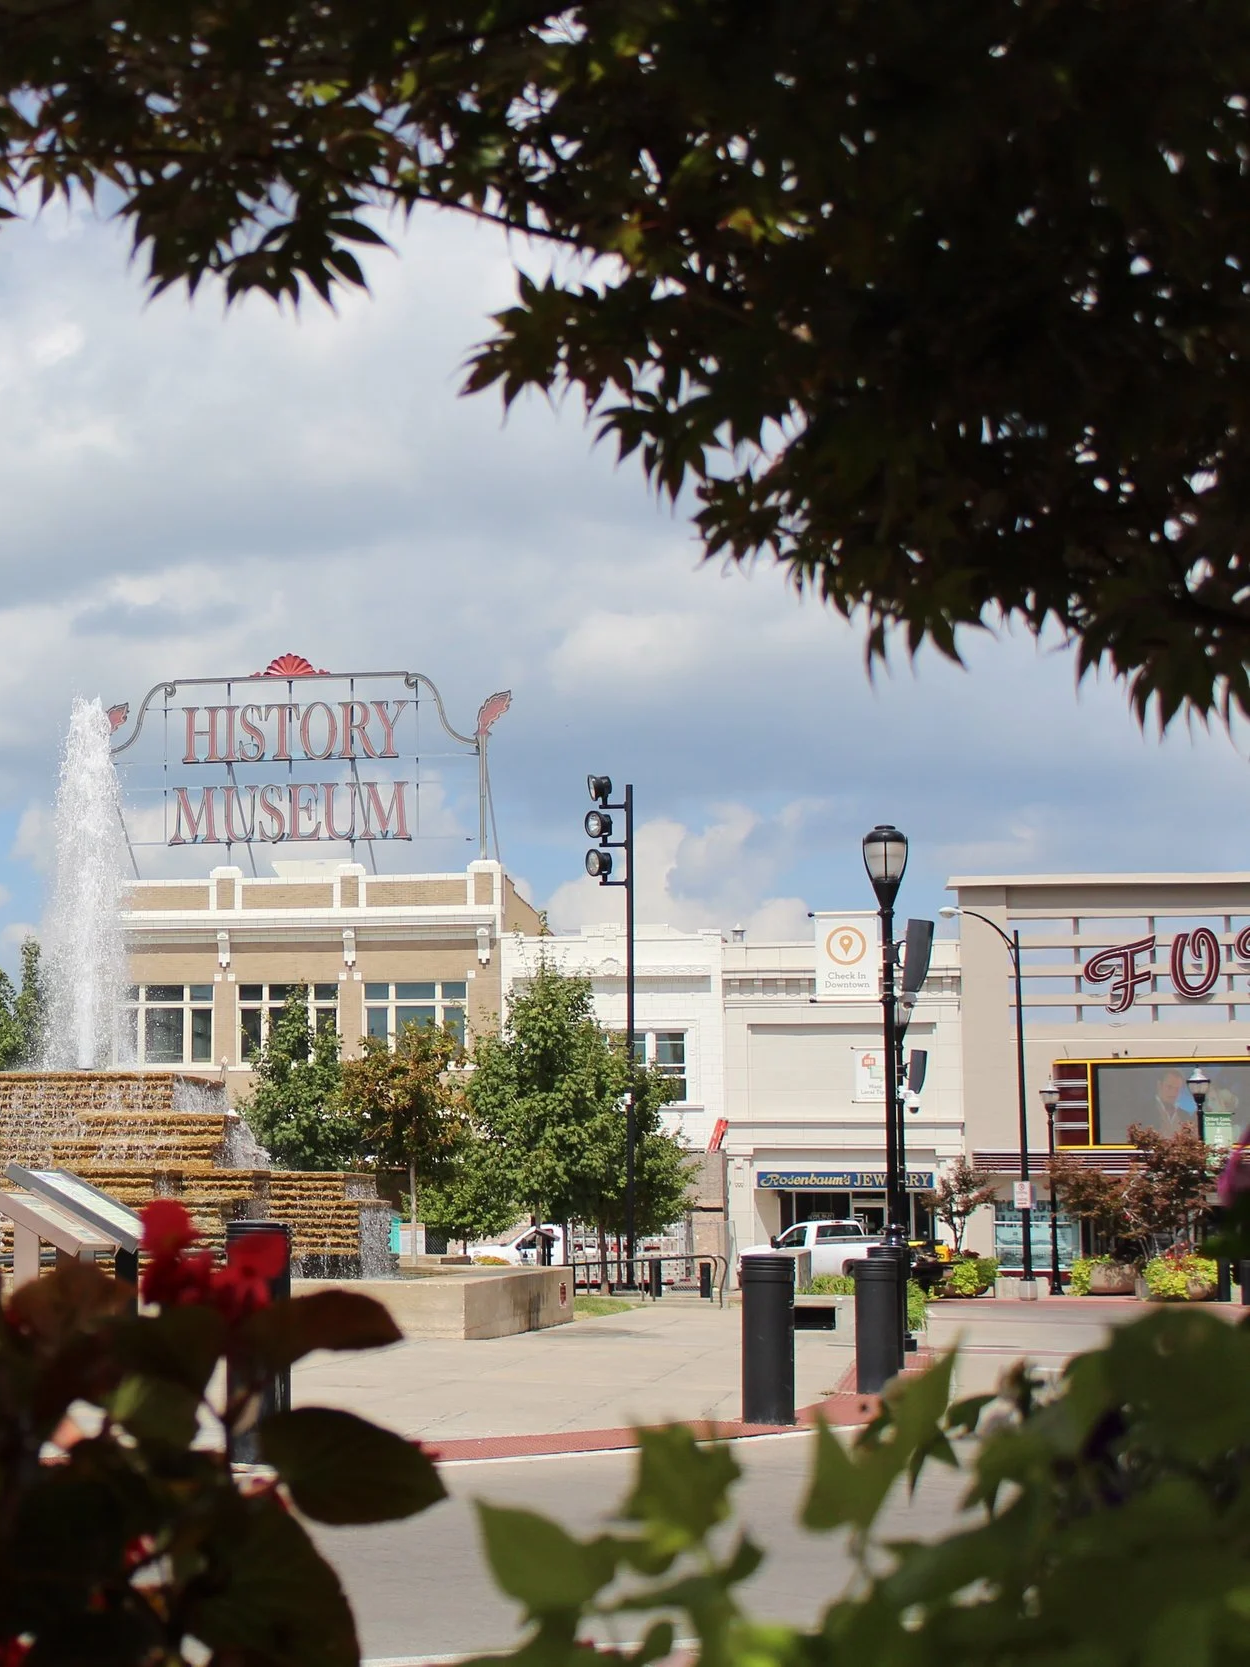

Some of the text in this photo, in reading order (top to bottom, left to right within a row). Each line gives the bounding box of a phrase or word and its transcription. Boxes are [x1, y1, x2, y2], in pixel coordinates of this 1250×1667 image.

[182, 701, 409, 764] HISTORY
[168, 781, 412, 846] MUSEUM
[827, 971, 867, 980] Check In
[824, 980, 870, 989] Downtown
[759, 1173, 931, 1187] Rosenbaum's JEWRY
